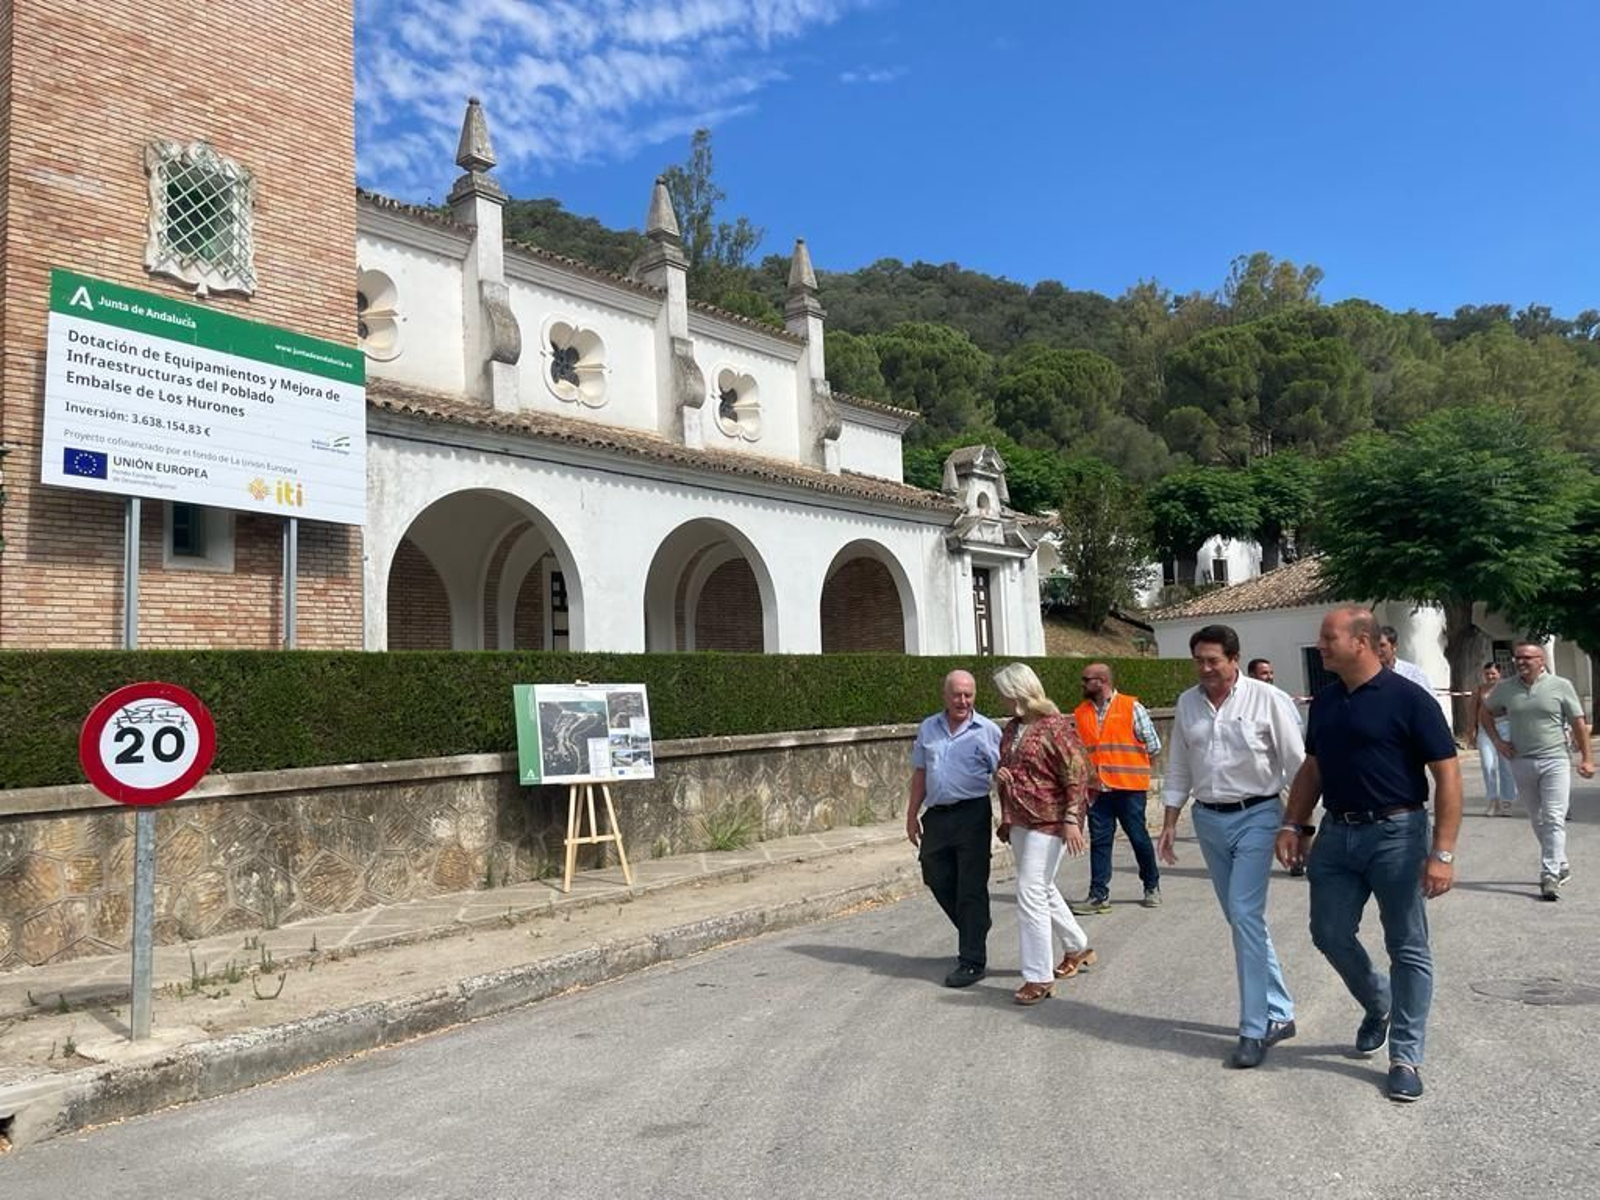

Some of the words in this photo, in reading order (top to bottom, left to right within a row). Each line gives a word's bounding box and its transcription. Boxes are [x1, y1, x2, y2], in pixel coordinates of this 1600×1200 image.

[98, 296, 129, 311] Junta
[131, 304, 144, 316] de
[66, 349, 193, 387] Infraestructuras
[196, 377, 218, 393] del
[222, 382, 275, 404] Poblado
[68, 329, 138, 356] Dotación
[142, 347, 160, 361] de
[164, 352, 266, 385] Equipamientos
[269, 378, 277, 390] y
[280, 379, 323, 398] Mejora
[325, 389, 340, 402] de
[66, 370, 132, 395] Embalse
[136, 384, 154, 399] de
[158, 389, 183, 405] Los
[186, 395, 245, 417] Hurones
[65, 401, 129, 423] Inversión:
[132, 413, 202, 435] 3.638.154,83
[204, 427, 212, 438] €
[63, 428, 105, 444] Proyecto
[107, 437, 164, 453] cofinanciado
[166, 446, 181, 456] por
[183, 446, 191, 456] el
[192, 448, 217, 461] fondo
[218, 453, 229, 464] de
[230, 455, 241, 466] La
[266, 463, 298, 476] Europea
[113, 455, 153, 471] UNIÓN
[156, 463, 208, 479] EUROPEA
[275, 479, 303, 507] iti
[114, 726, 185, 764] 20
